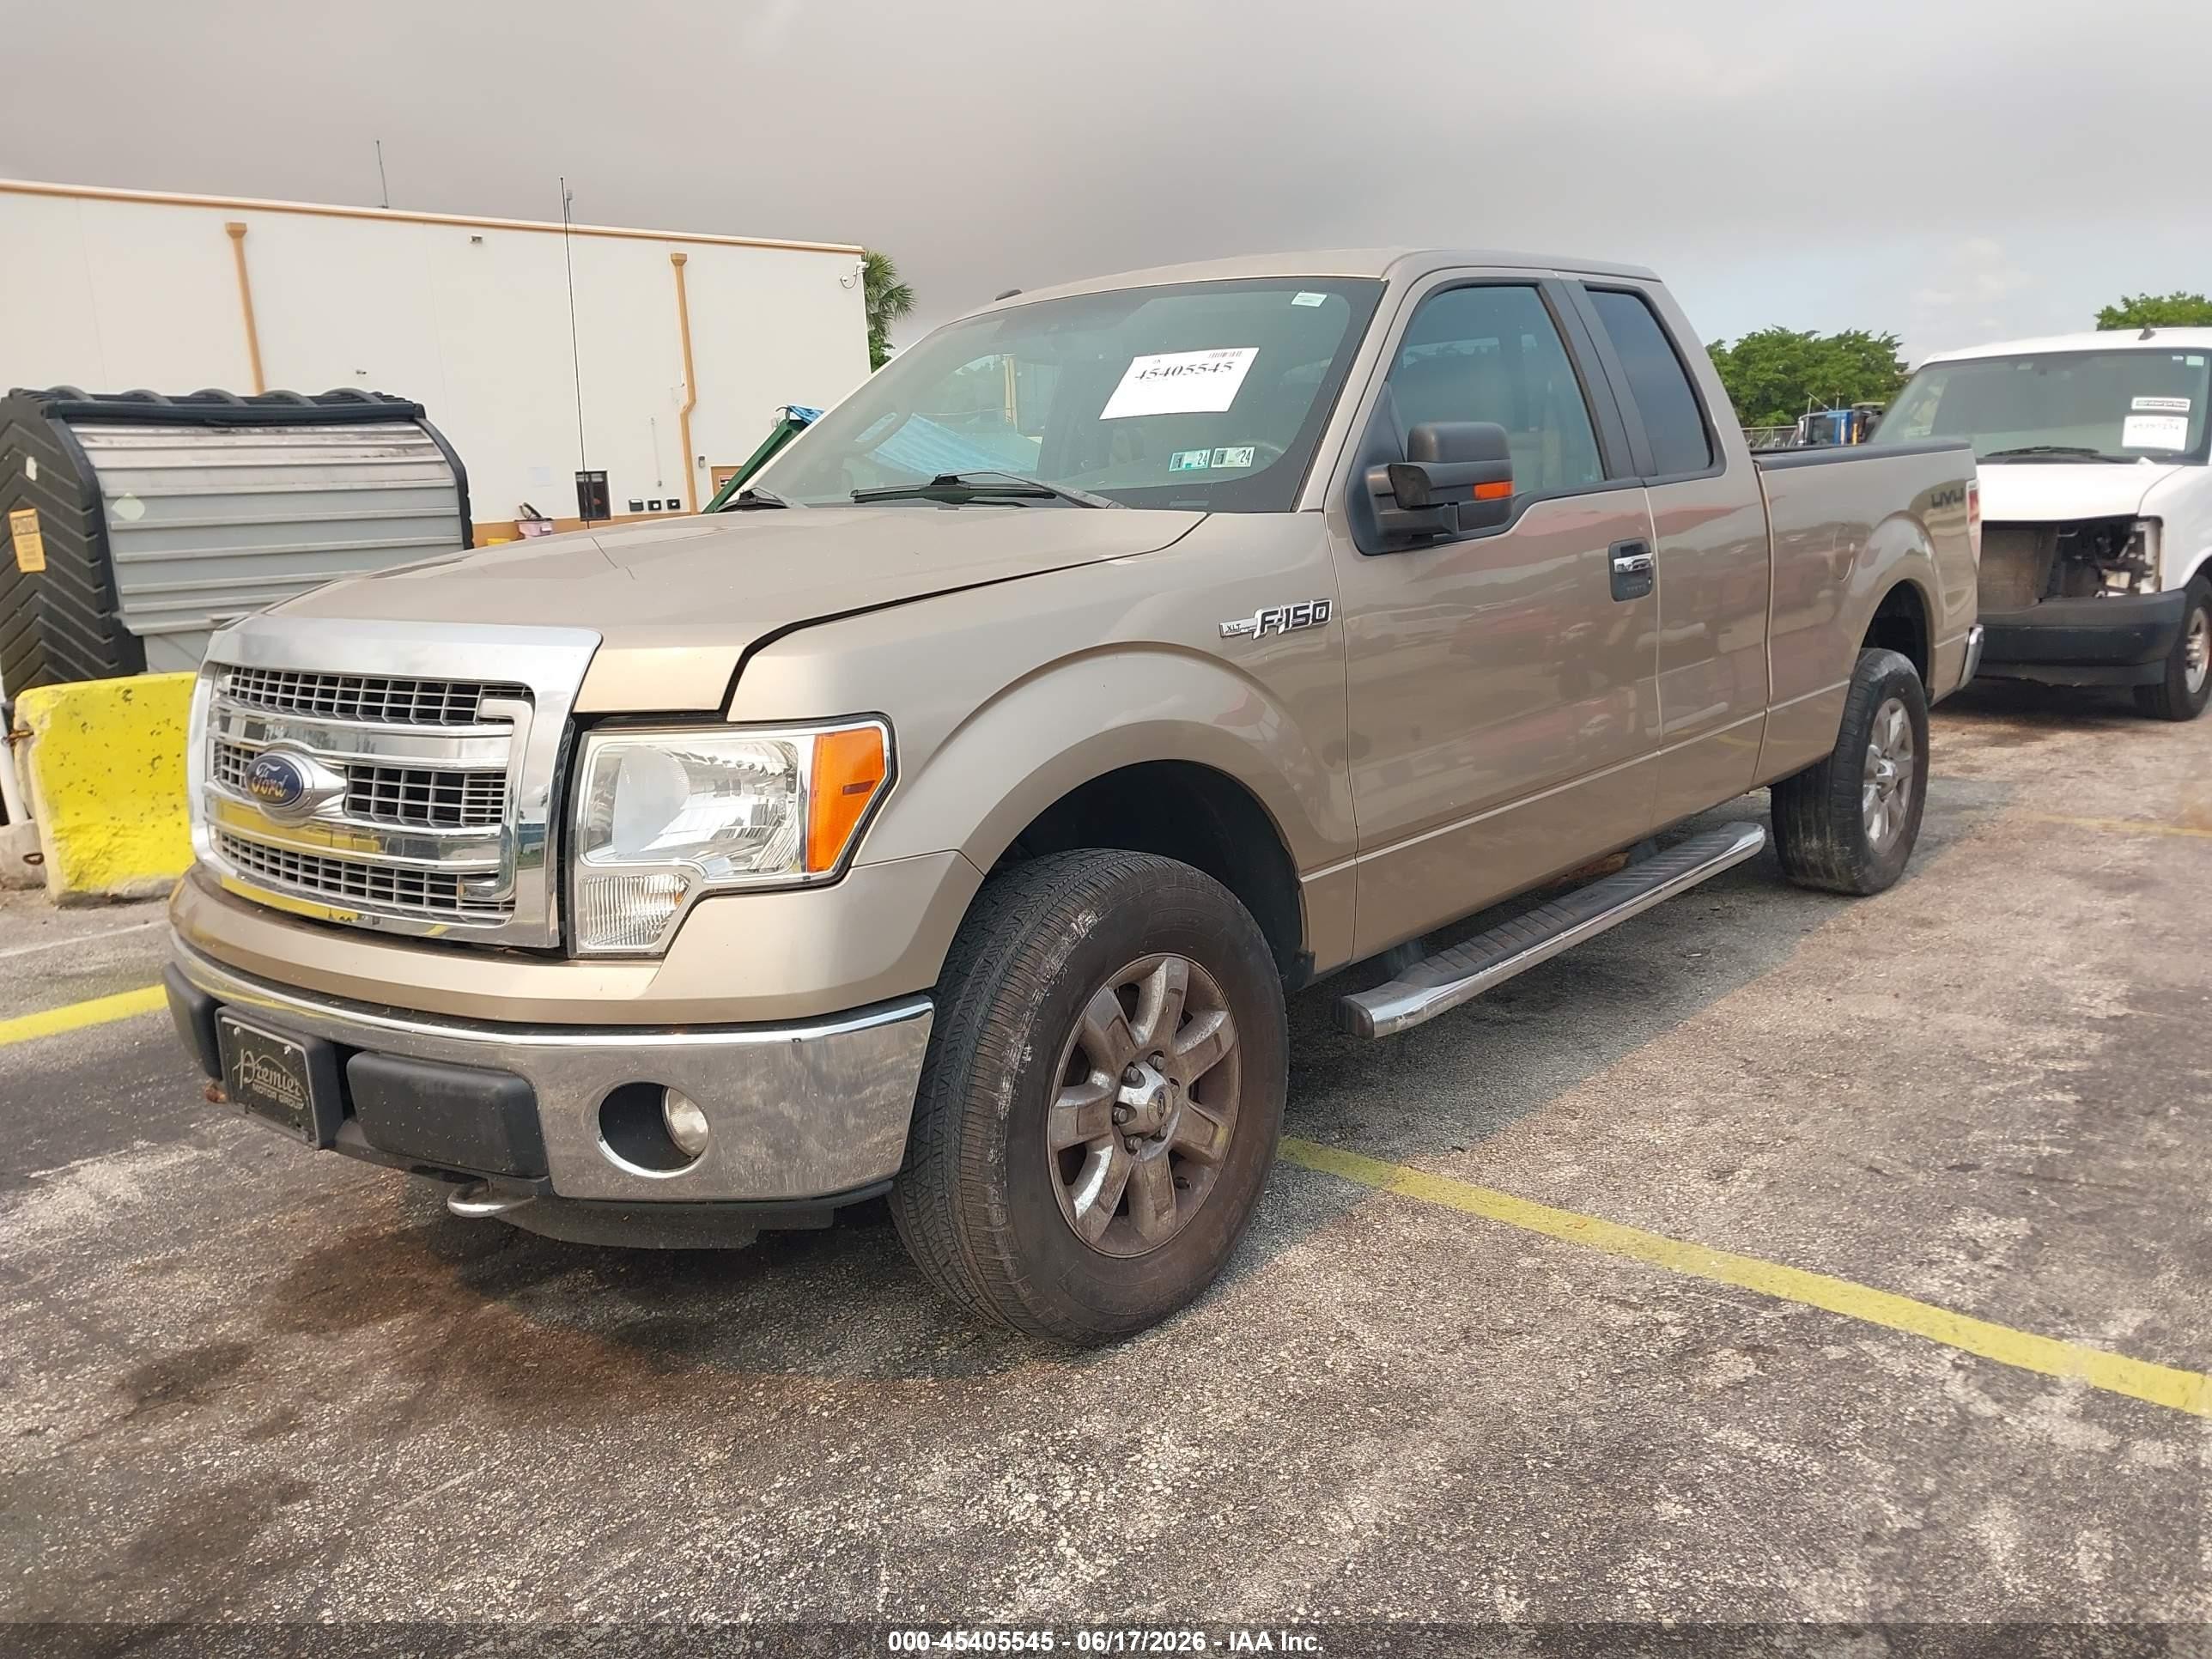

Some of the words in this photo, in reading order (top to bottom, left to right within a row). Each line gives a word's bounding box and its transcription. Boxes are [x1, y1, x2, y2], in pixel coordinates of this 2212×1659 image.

[1134, 361, 1236, 380] 45405545
[1196, 452, 1209, 465] 24
[1239, 449, 1252, 464] 24
[1225, 623, 1242, 633] XLT
[1254, 600, 1332, 637] F-150
[251, 762, 289, 799] Ford
[234, 1048, 302, 1096] Premier
[252, 1083, 277, 1101] MOTOR
[278, 1093, 305, 1110] GROUP
